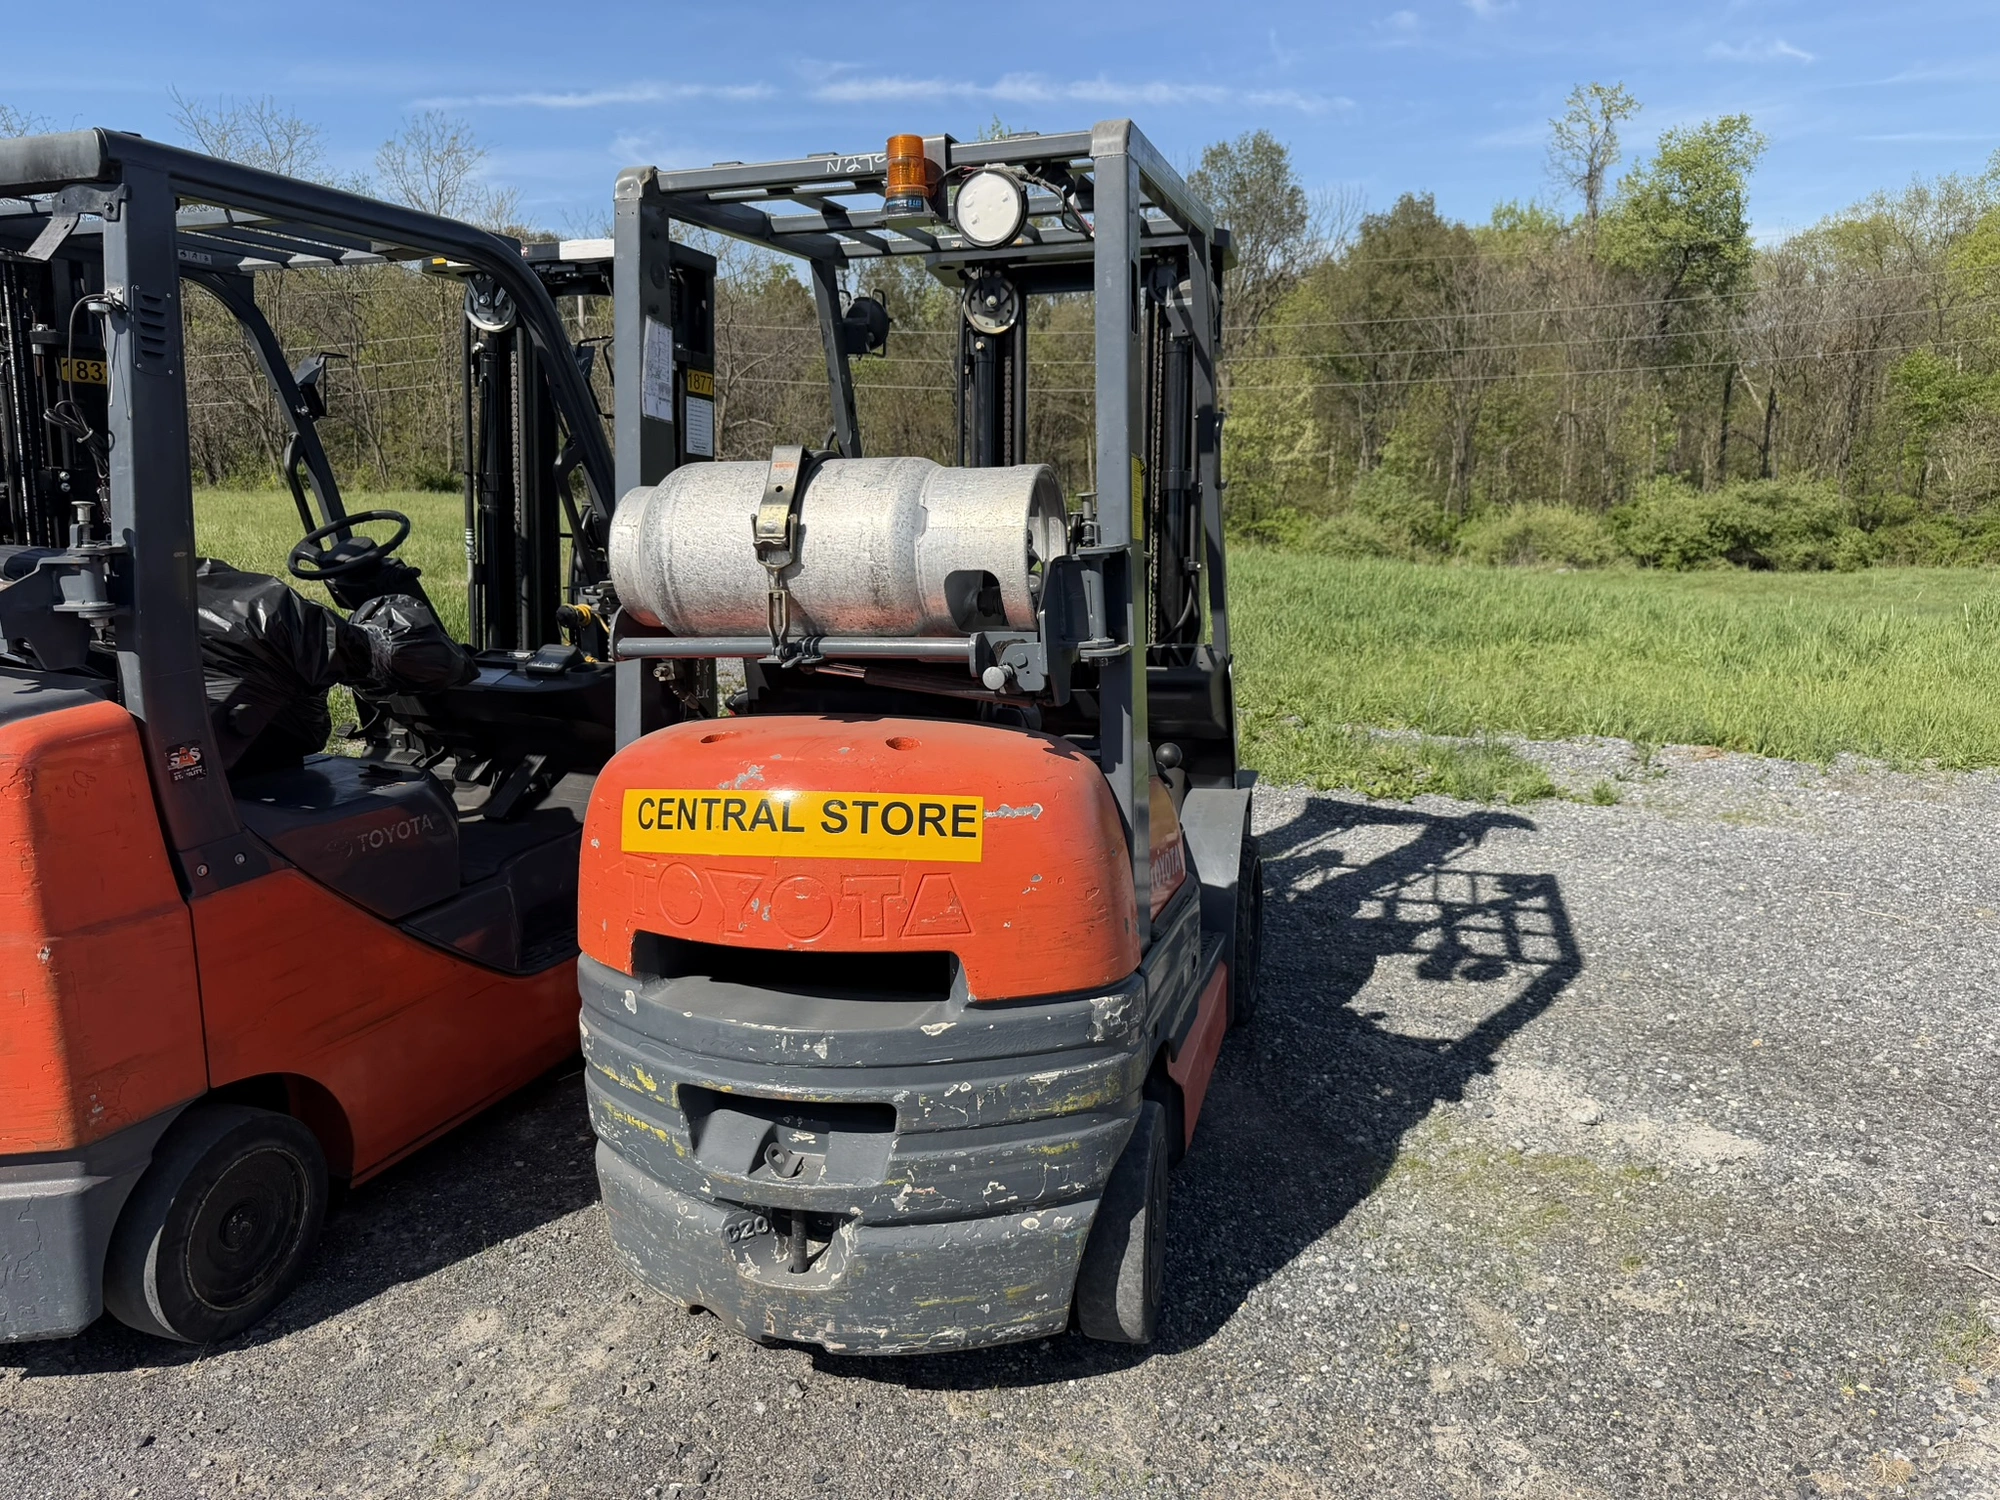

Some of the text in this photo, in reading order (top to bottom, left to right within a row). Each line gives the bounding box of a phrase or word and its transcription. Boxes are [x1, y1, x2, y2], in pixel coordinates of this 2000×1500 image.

[62, 359, 107, 381] 183
[688, 372, 713, 391] 1877
[357, 814, 434, 852] TOYOTA
[637, 797, 977, 838] CENTRAL STORE
[623, 854, 975, 942] TOYOTA
